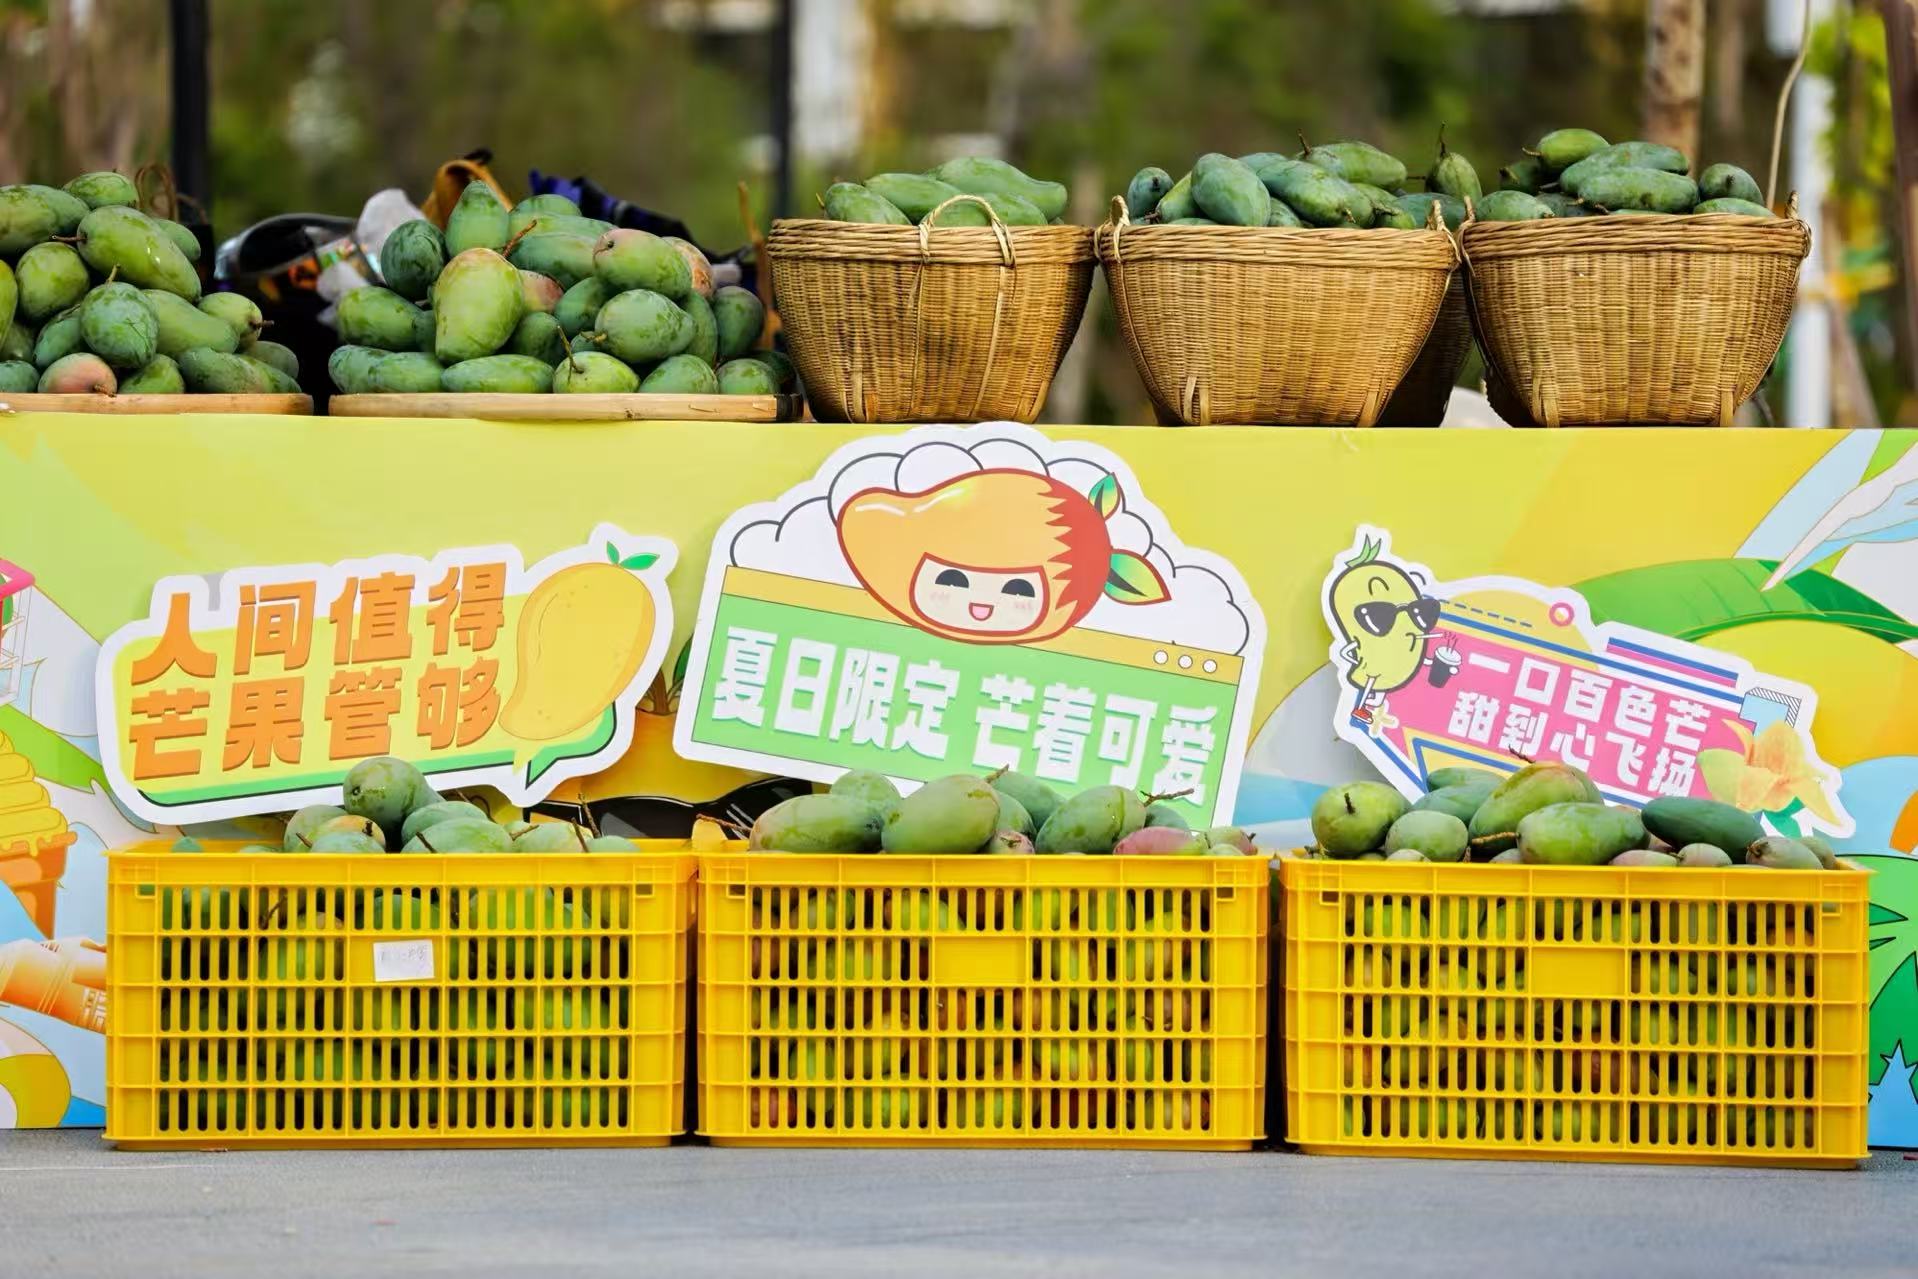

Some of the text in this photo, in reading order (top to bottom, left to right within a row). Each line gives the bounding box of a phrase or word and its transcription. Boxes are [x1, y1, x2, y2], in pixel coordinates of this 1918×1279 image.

[131, 562, 506, 684] 人间值得
[130, 657, 499, 780] 芒果管够
[712, 626, 1218, 805] 夏日限定 芒着可爱
[1448, 690, 1700, 798] 甜到心飞扬
[1468, 652, 1711, 752] 一口百色芒
